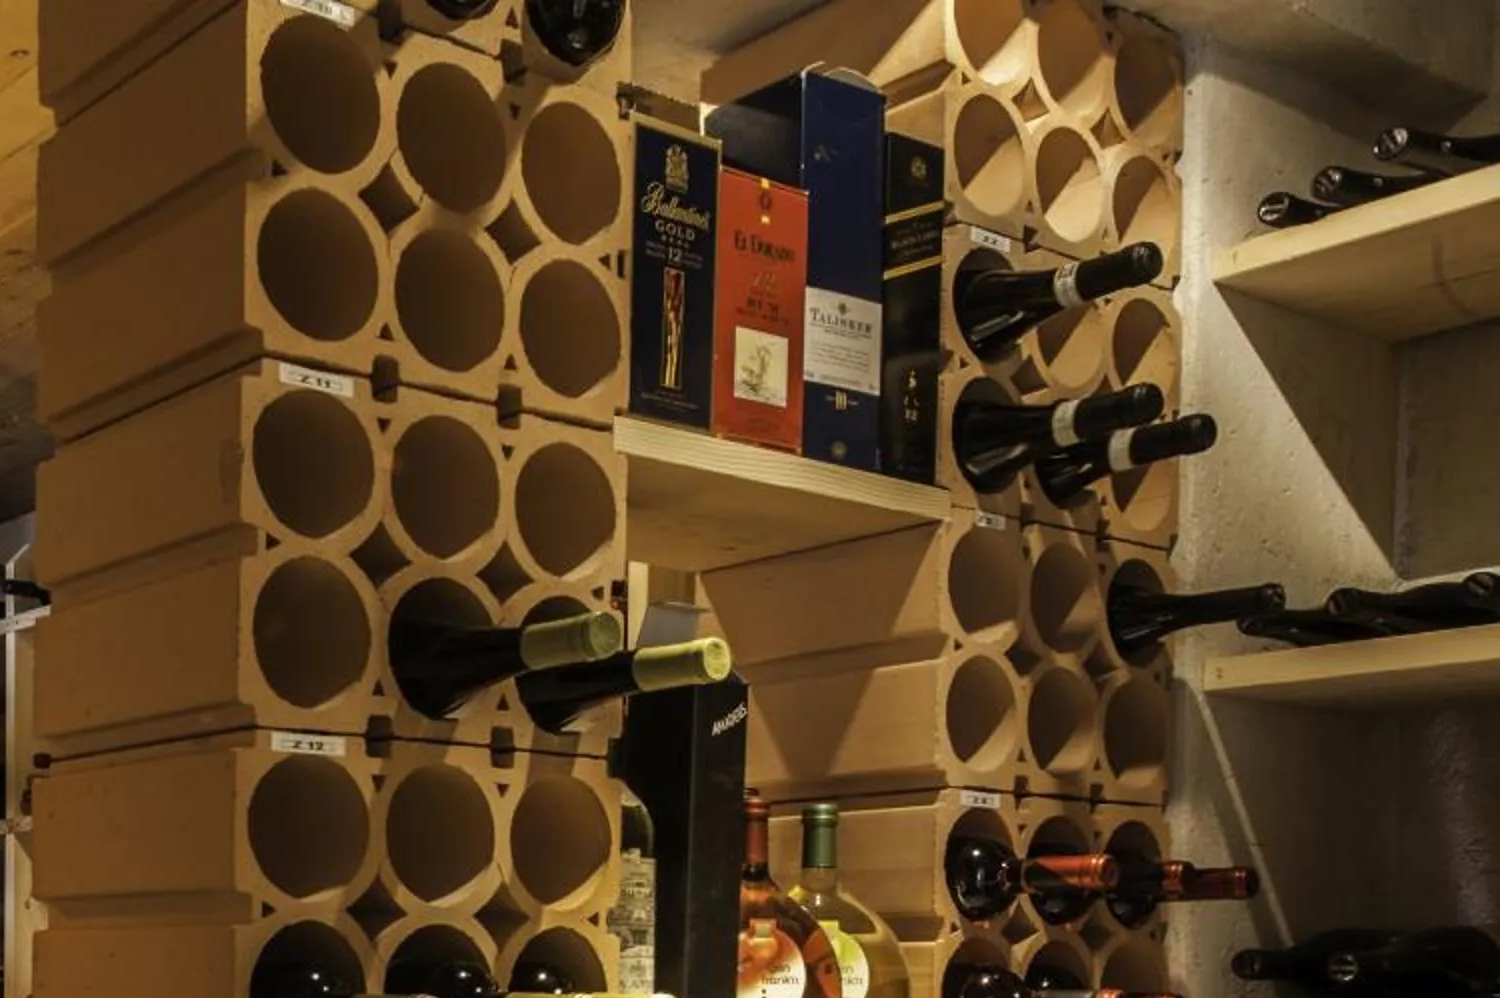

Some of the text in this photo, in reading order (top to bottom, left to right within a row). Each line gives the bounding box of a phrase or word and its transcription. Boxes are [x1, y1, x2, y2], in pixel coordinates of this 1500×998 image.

[655, 219, 696, 241] GOLD
[808, 306, 874, 334] TALISKER
[308, 740, 324, 751] 12
